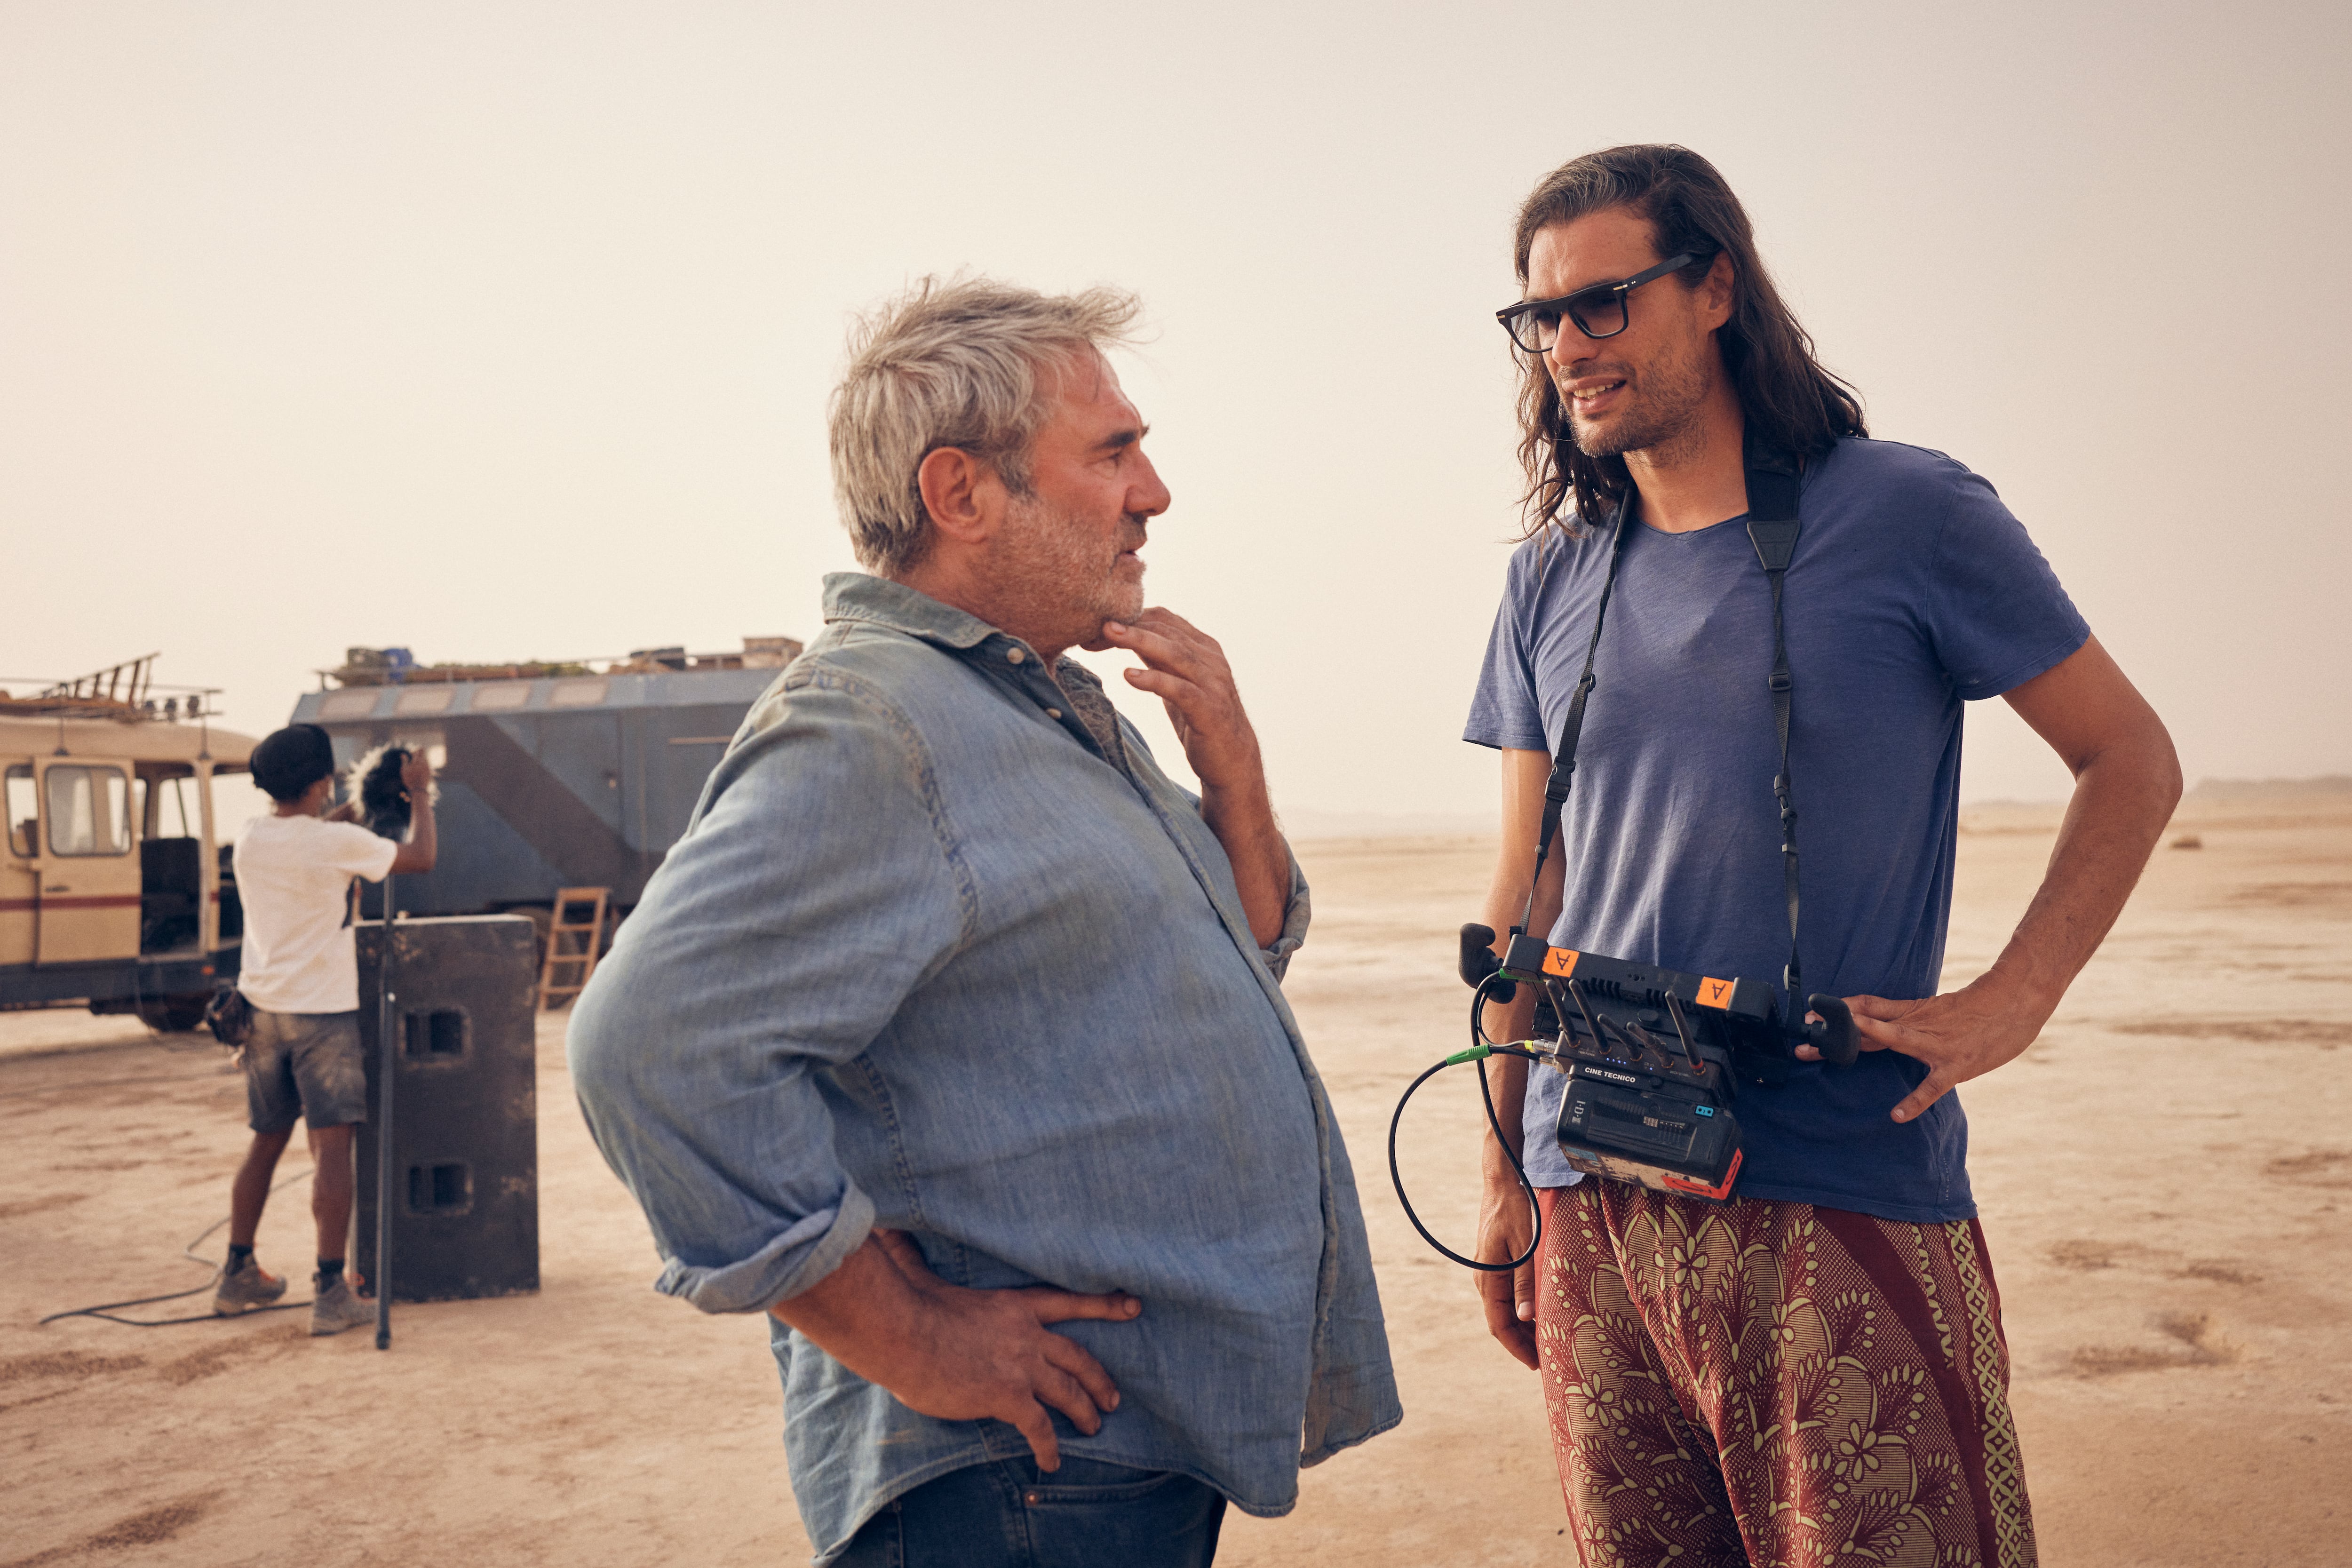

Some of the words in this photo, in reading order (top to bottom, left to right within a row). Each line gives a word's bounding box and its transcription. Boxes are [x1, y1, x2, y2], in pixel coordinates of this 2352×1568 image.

[1556, 951, 1570, 970] A
[1712, 983, 1726, 1000] A
[1585, 1067, 1603, 1076] CINE
[1604, 1071, 1636, 1083] TECNICO
